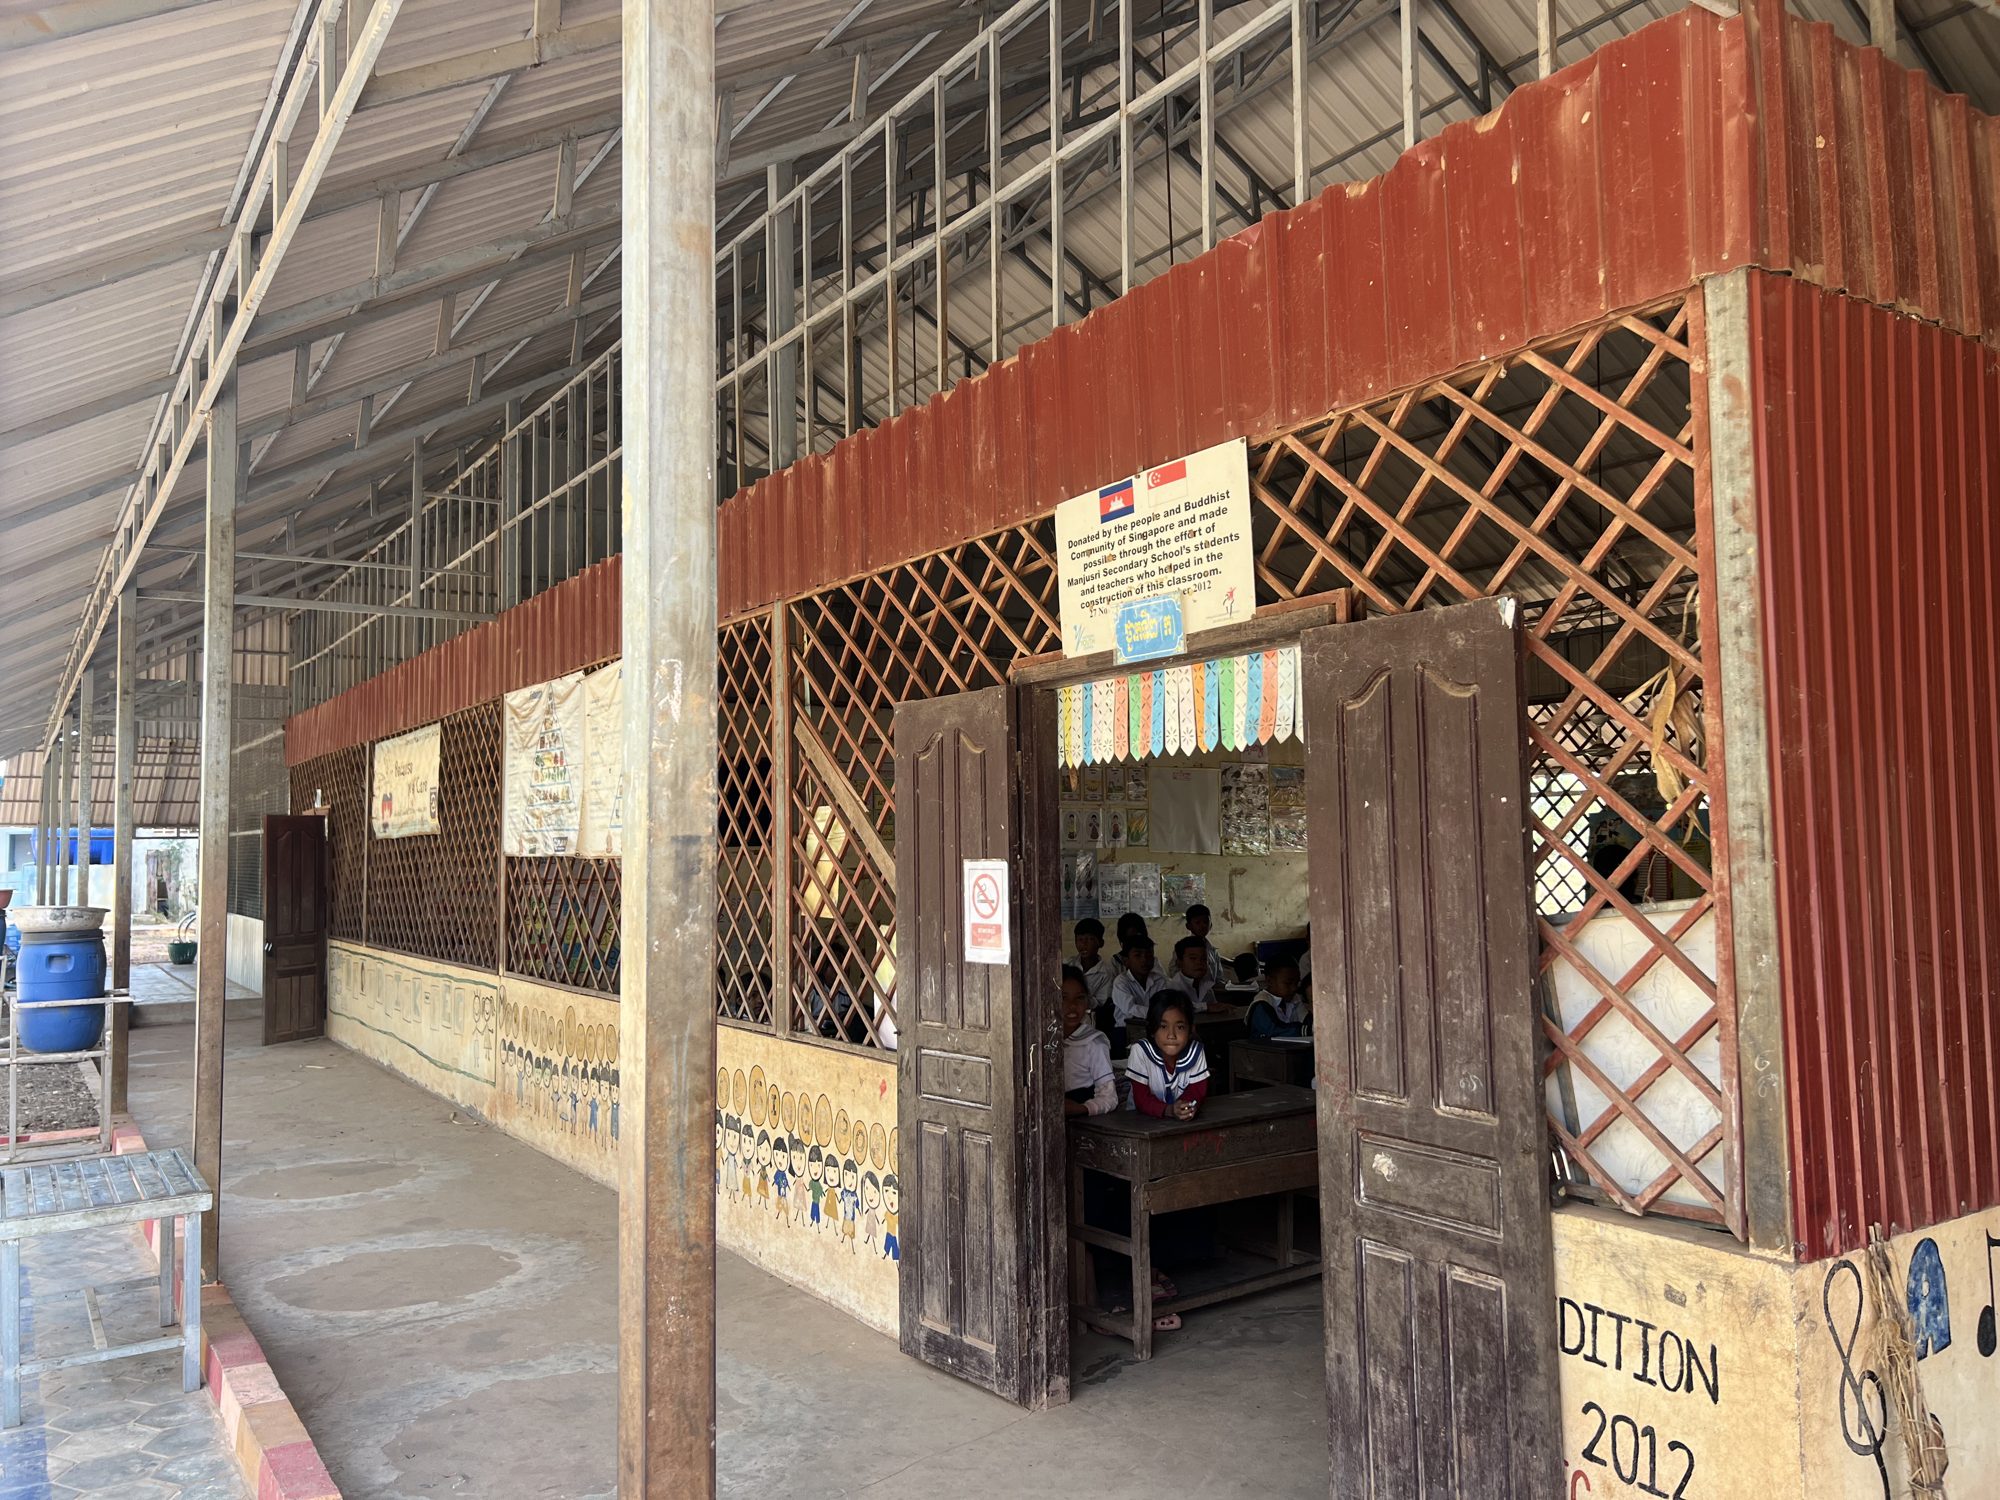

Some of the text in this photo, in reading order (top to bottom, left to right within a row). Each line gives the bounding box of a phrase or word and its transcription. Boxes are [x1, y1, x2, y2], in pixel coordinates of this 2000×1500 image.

[1068, 489, 1230, 549] Donated by the people and Buddhist
[1117, 535, 1126, 546] of
[1128, 522, 1175, 543] Singapore
[1177, 514, 1196, 528] and
[1199, 506, 1228, 521] made
[1067, 532, 1240, 587] Manjusri Secondary School's students
[1083, 553, 1117, 572] possie
[1119, 541, 1153, 559] through
[1156, 537, 1171, 548] the
[1205, 522, 1216, 534] of
[1080, 552, 1223, 597] and teachers who helped in the
[1080, 589, 1133, 609] construction
[1135, 584, 1144, 595] of
[1147, 580, 1164, 592] this
[1167, 567, 1222, 587] classroom.
[1193, 580, 1212, 593] 2012
[1556, 1296, 1719, 1405] DITION
[1581, 1401, 1695, 1500] 2012
